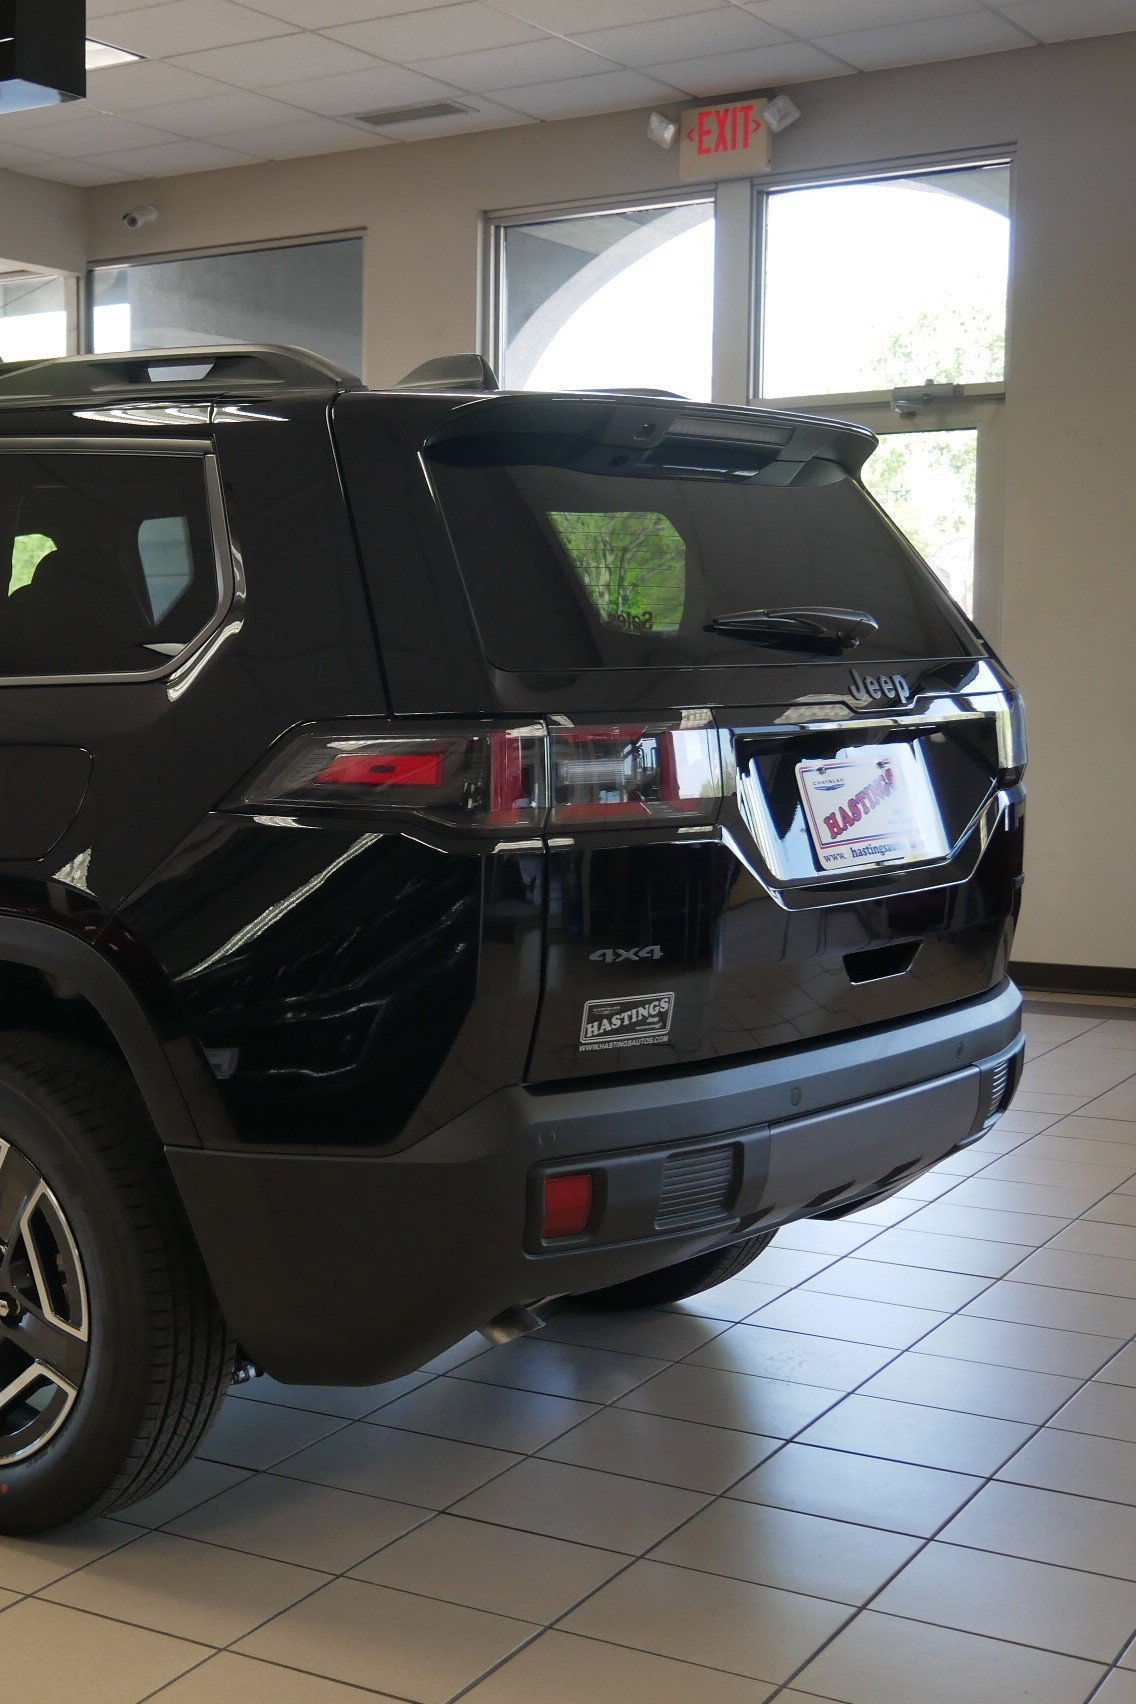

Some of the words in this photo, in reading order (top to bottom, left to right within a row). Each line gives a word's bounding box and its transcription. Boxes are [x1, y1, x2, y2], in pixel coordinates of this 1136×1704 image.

[697, 105, 754, 156] EXIT
[847, 668, 910, 704] Jeep
[823, 768, 896, 840] HASTINGS
[585, 998, 669, 1038] HASTINGS
[579, 1036, 669, 1052] WWW.HASTINGSAUTOS.COM
